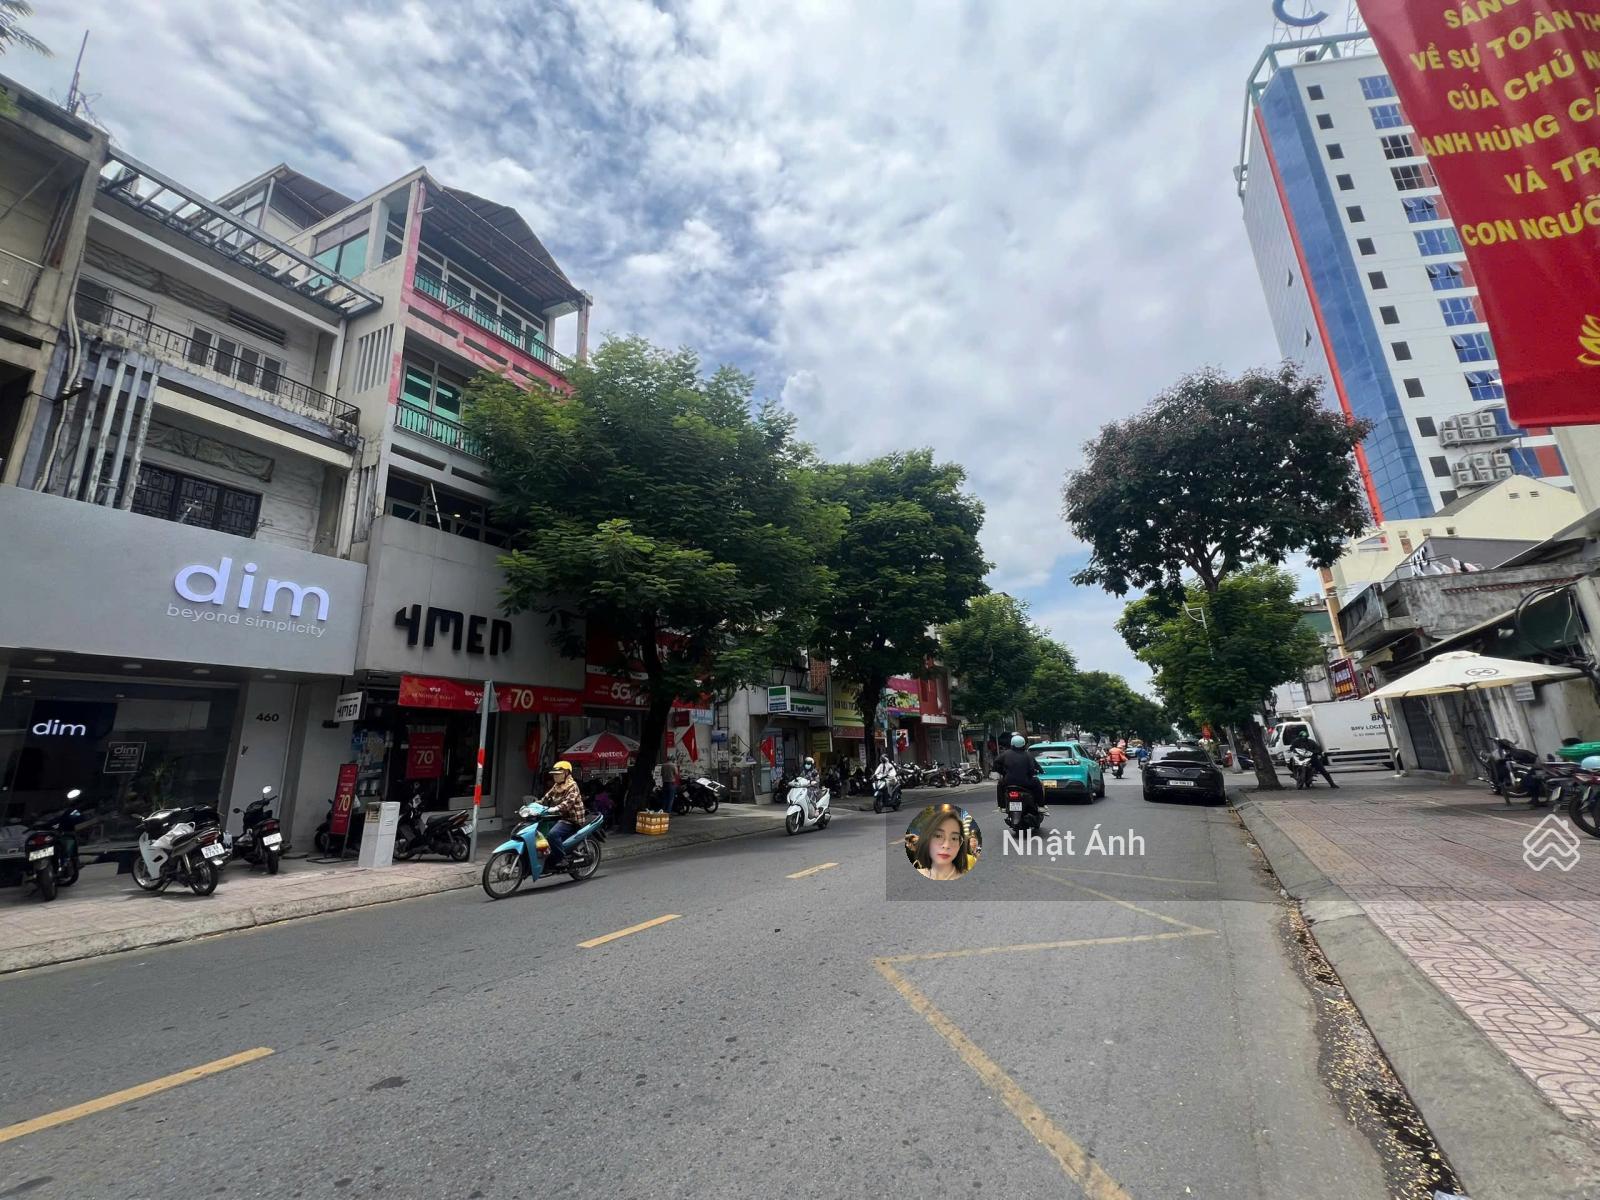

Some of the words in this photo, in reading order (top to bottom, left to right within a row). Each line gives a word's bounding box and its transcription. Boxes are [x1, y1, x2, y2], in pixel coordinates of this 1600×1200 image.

[1409, 42, 1444, 72] VỀ
[1447, 43, 1481, 73] SỰ
[1486, 9, 1576, 60] TOÀN
[1447, 83, 1499, 110] CỦA
[1503, 48, 1576, 102] CHỦ
[1581, 48, 1600, 70] N
[1421, 132, 1473, 157] ANH
[1475, 114, 1560, 151] HÙNG
[1504, 165, 1548, 195] VÀ
[1461, 219, 1519, 246] CON
[174, 557, 330, 621] dim
[167, 603, 241, 624] beyond
[245, 616, 326, 637] simplicity
[511, 688, 534, 709] 70
[32, 719, 86, 736] dim
[256, 713, 280, 722] 460
[114, 746, 138, 754] dim
[416, 750, 434, 765] 70
[338, 794, 351, 812] 70
